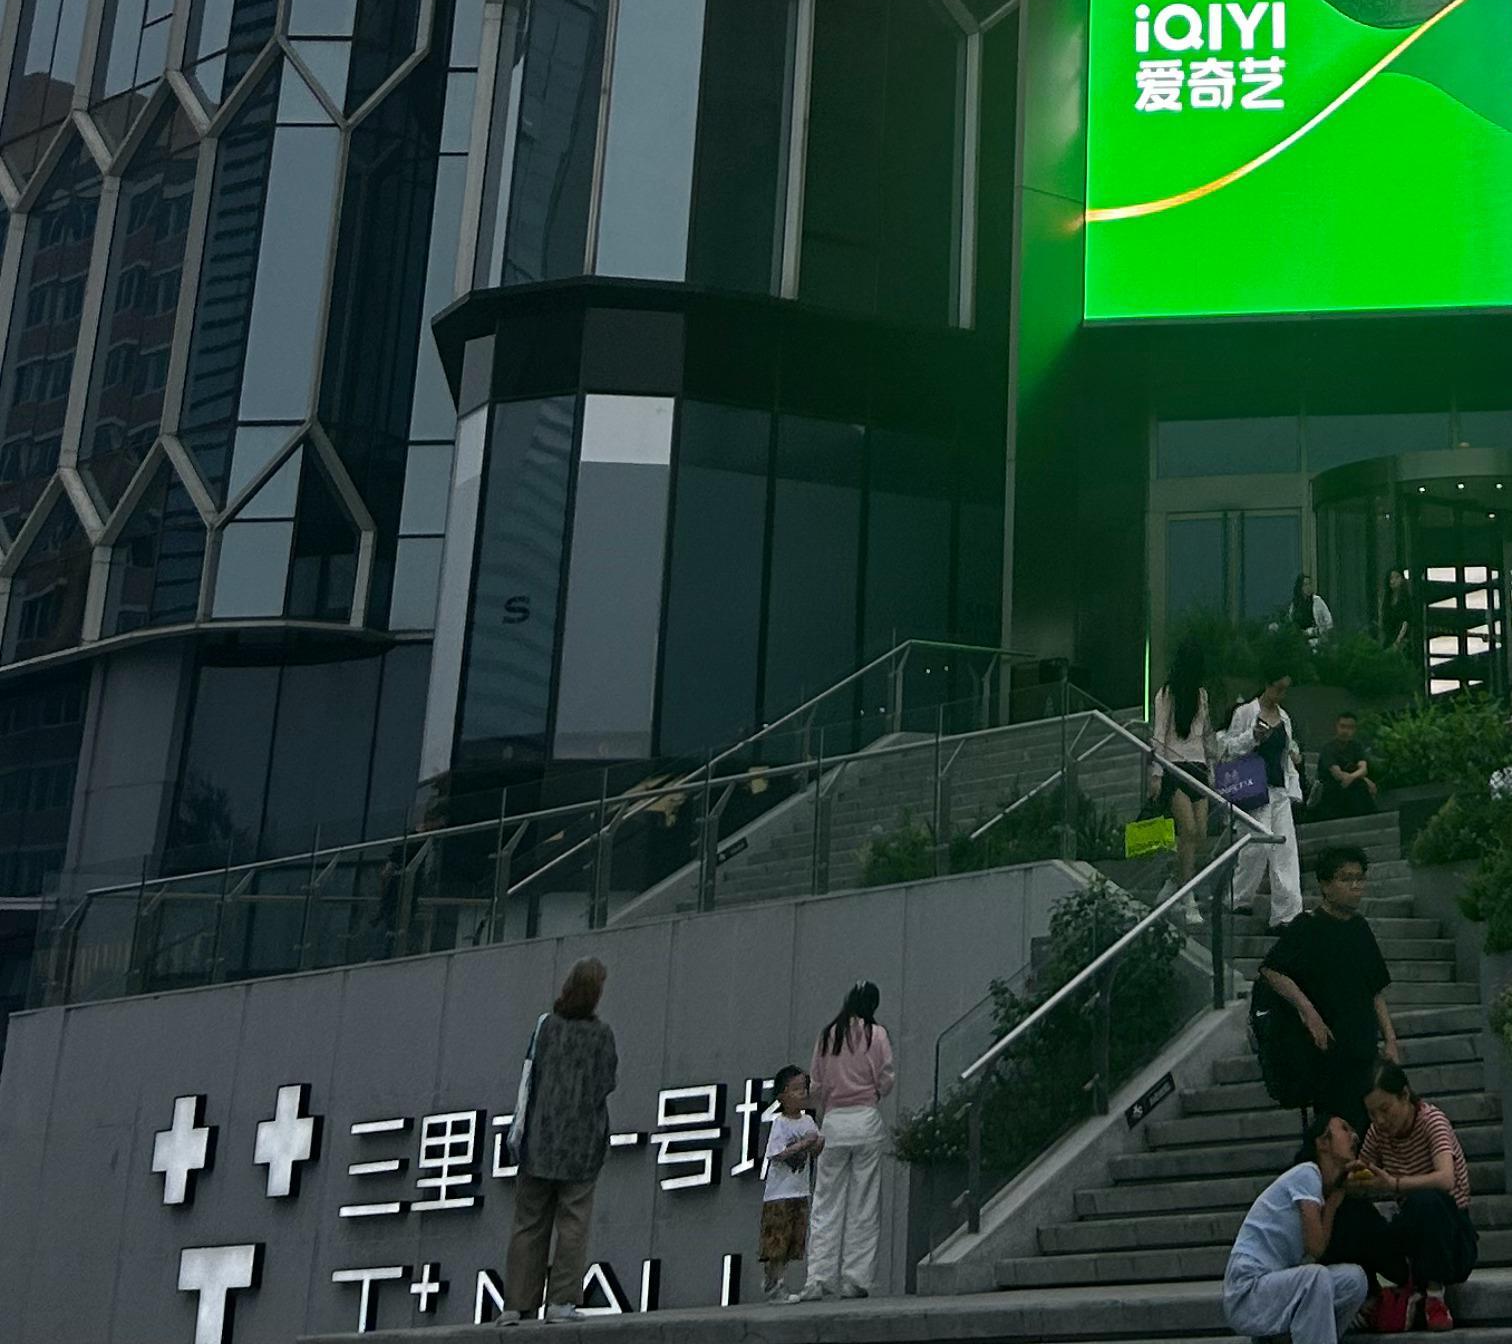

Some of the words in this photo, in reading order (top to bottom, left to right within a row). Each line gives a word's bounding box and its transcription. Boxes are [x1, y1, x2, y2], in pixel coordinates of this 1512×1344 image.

[1134, 1, 1286, 52] iQIYI
[1134, 56, 1287, 112] 爱奇艺
